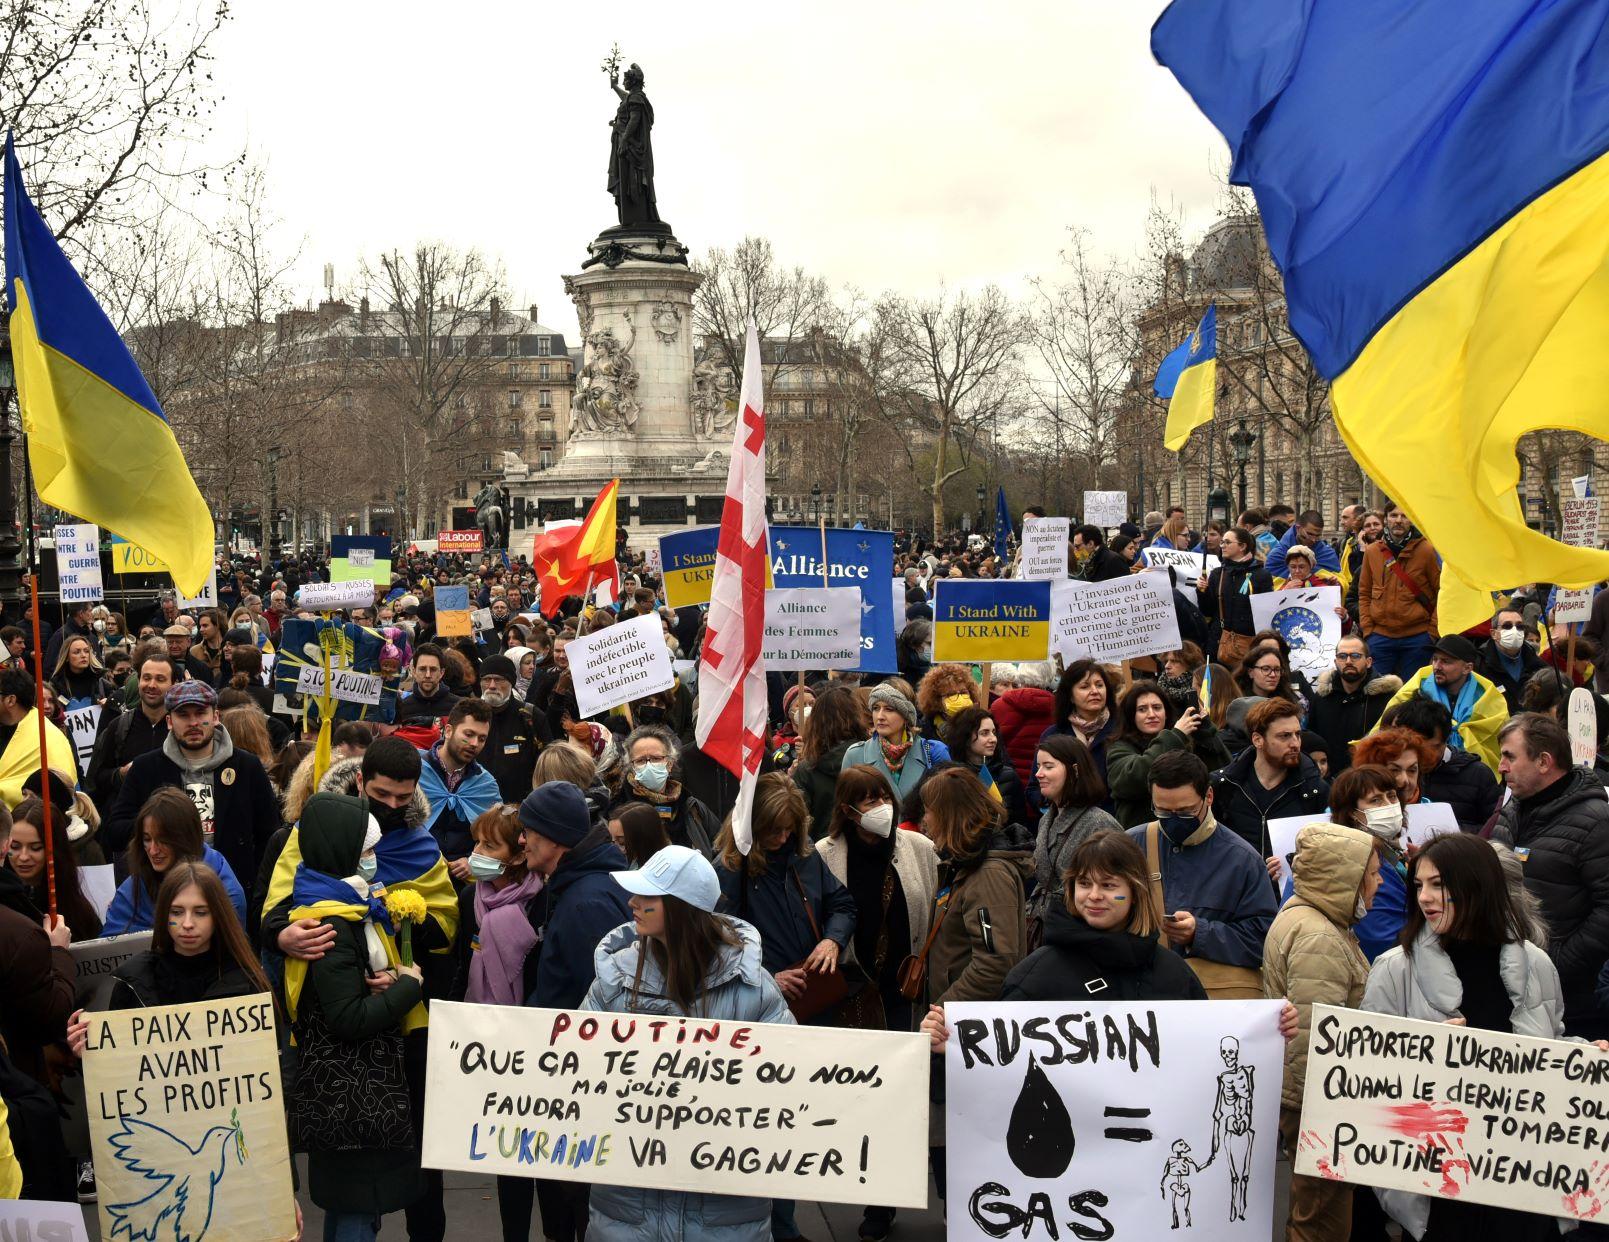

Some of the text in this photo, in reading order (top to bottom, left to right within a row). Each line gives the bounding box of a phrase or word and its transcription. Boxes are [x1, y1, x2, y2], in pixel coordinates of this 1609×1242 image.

[448, 533, 480, 541] Labour
[1026, 525, 1040, 533] NON
[86, 543, 94, 552] LA
[123, 545, 166, 566] VOU
[68, 557, 99, 568] GUERRE
[674, 555, 680, 566] I
[772, 555, 869, 579] Alliance
[1028, 558, 1040, 566] OUI
[62, 587, 102, 599] POUTINE
[304, 583, 336, 592] SOLDATS
[1134, 580, 1148, 590] de
[305, 595, 341, 604] RETOURNEZ
[1124, 594, 1140, 603] est
[1143, 591, 1157, 600] un
[777, 603, 826, 613] Alliance
[949, 604, 1038, 618] I Stand With
[1059, 598, 1171, 626] crime contre la paix,
[764, 626, 838, 637] des Femmes
[956, 625, 1030, 638] UKRAINE
[1064, 610, 1170, 636] un crime de guerre,
[1076, 622, 1161, 645] un crime contre
[588, 627, 638, 654] Solidarité
[586, 642, 646, 670] indéfectible
[779, 649, 788, 659] la
[793, 648, 854, 660] Démocratie
[586, 652, 656, 684] avec le peuple
[304, 668, 335, 686] STOP
[336, 674, 378, 695] POUTINE
[598, 670, 648, 694] ukrainien
[85, 1003, 272, 1052] LA PAIX PASSE
[138, 1045, 223, 1082] AVANT
[538, 1051, 579, 1077] ÇA
[604, 1050, 639, 1075] TE
[756, 1061, 795, 1084] OU
[809, 1063, 883, 1088] NON,
[100, 1072, 272, 1120] LES PROFITS
[572, 1079, 607, 1095] MA
[1412, 1074, 1436, 1101] LE
[1566, 1096, 1609, 1120] SOL
[483, 1091, 581, 1121] FAUDRA
[629, 1136, 667, 1166] VA
[690, 1141, 844, 1177] GAGNER
[968, 1182, 1114, 1241] GAS
